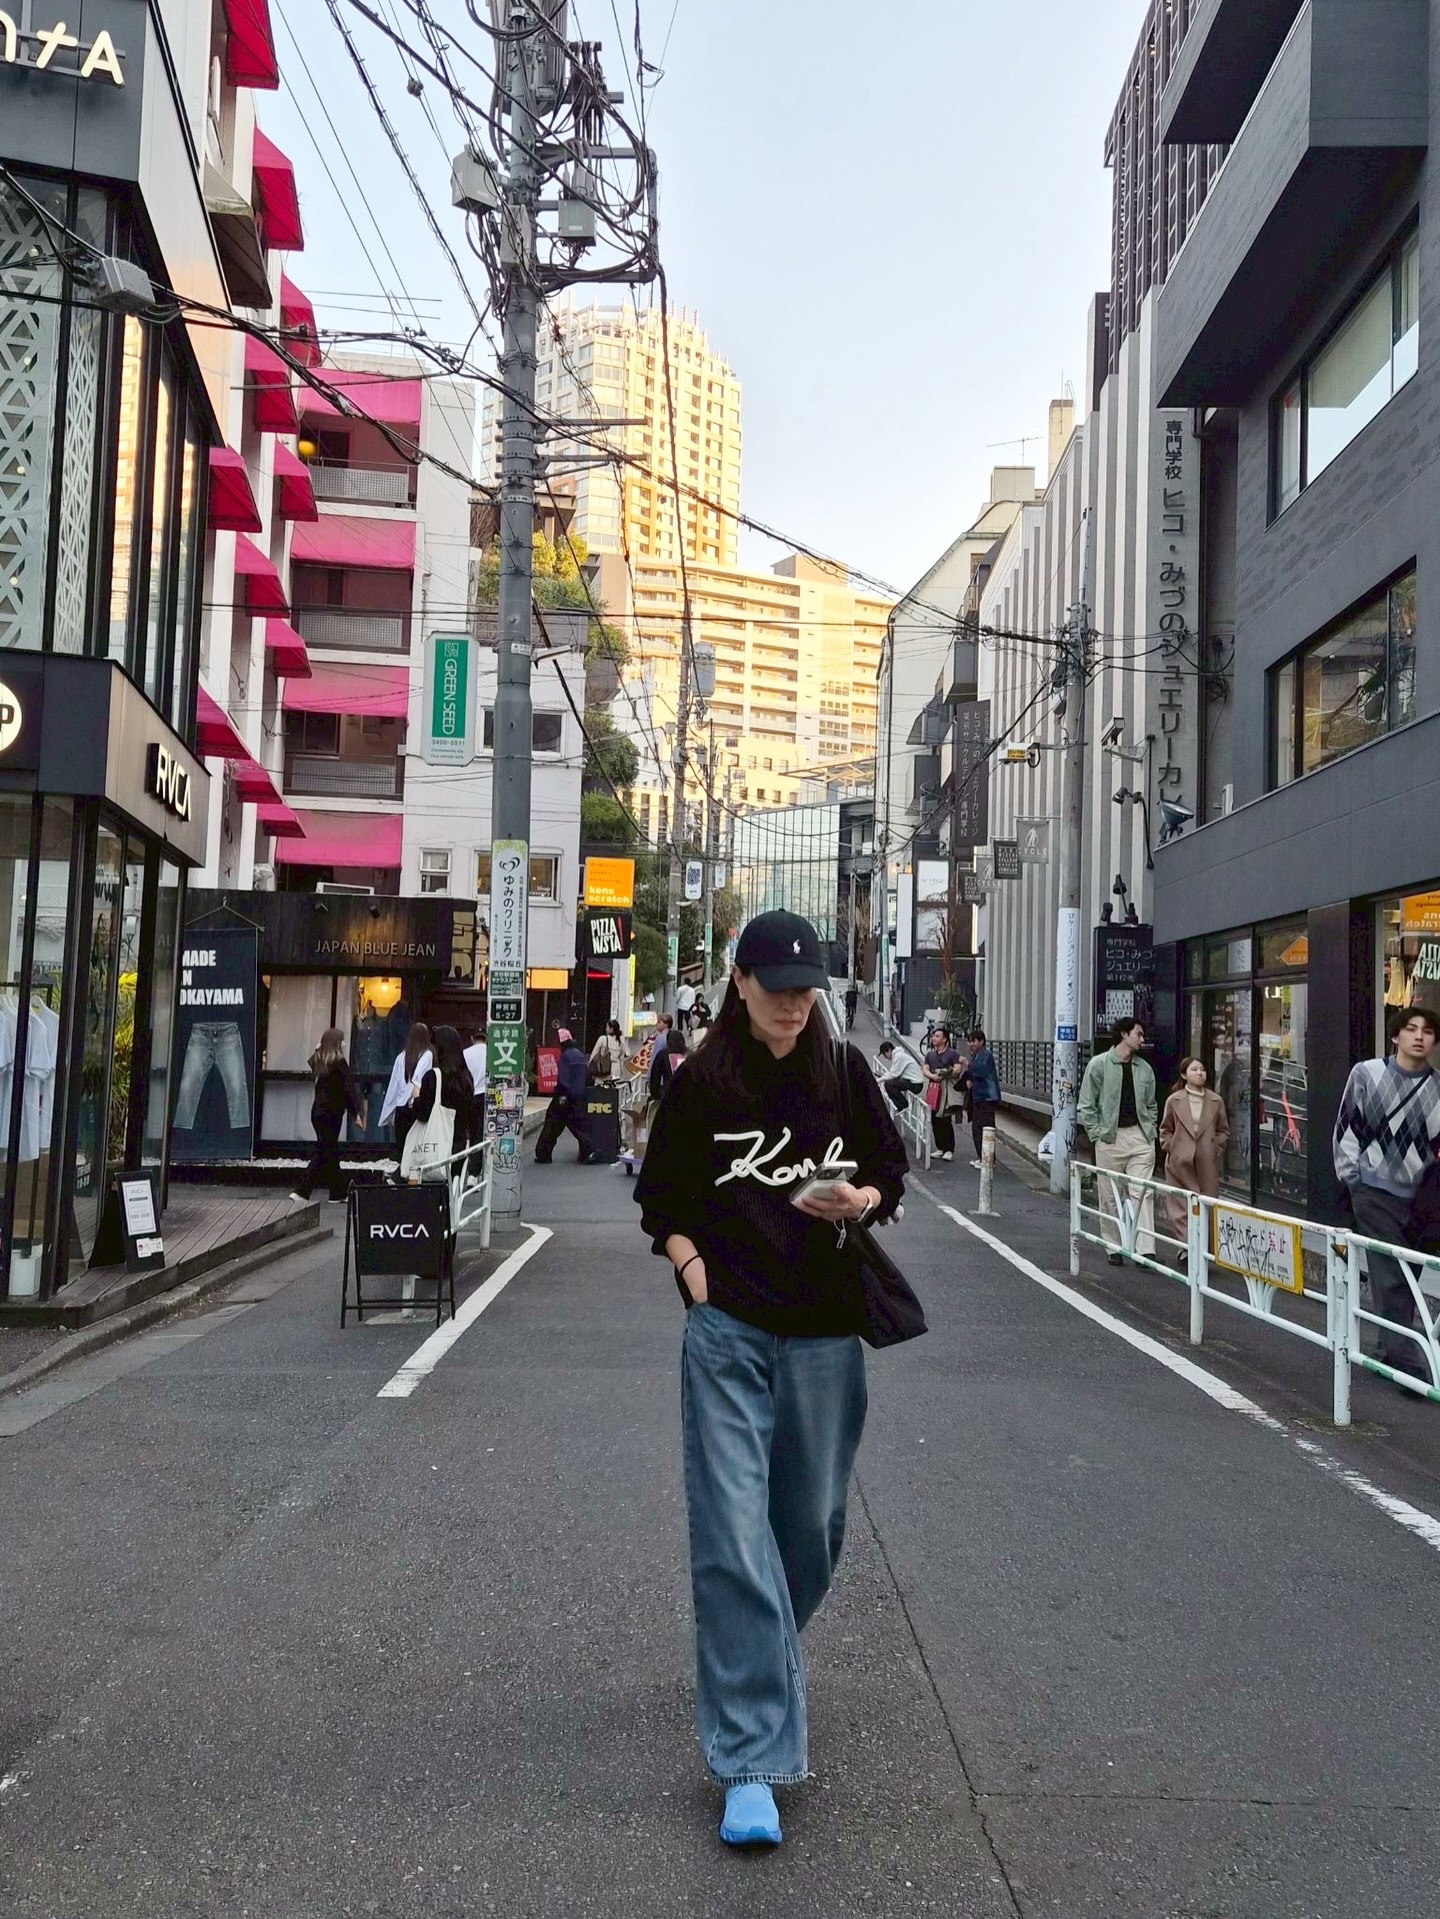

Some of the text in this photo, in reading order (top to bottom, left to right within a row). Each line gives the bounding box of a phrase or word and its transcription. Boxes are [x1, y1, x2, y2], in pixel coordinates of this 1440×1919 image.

[1165, 420, 1183, 480] 専門学校
[442, 658, 458, 735] GREEN SEED
[156, 743, 192, 822] RVCA
[588, 894, 630, 904] scratch
[589, 885, 615, 895] kens
[503, 875, 515, 958] ゆみのクリニック
[590, 917, 618, 937] PIZZA
[315, 940, 436, 957] JAPAN BLUE JEAN
[592, 934, 623, 954] NISTA
[1105, 947, 1156, 960] ヒコ・みづ
[181, 969, 192, 987] N
[180, 988, 244, 1006] OKAYAMA
[494, 1039, 518, 1066] 文
[587, 1102, 613, 1114] FTC
[370, 1223, 430, 1239] RVCA
